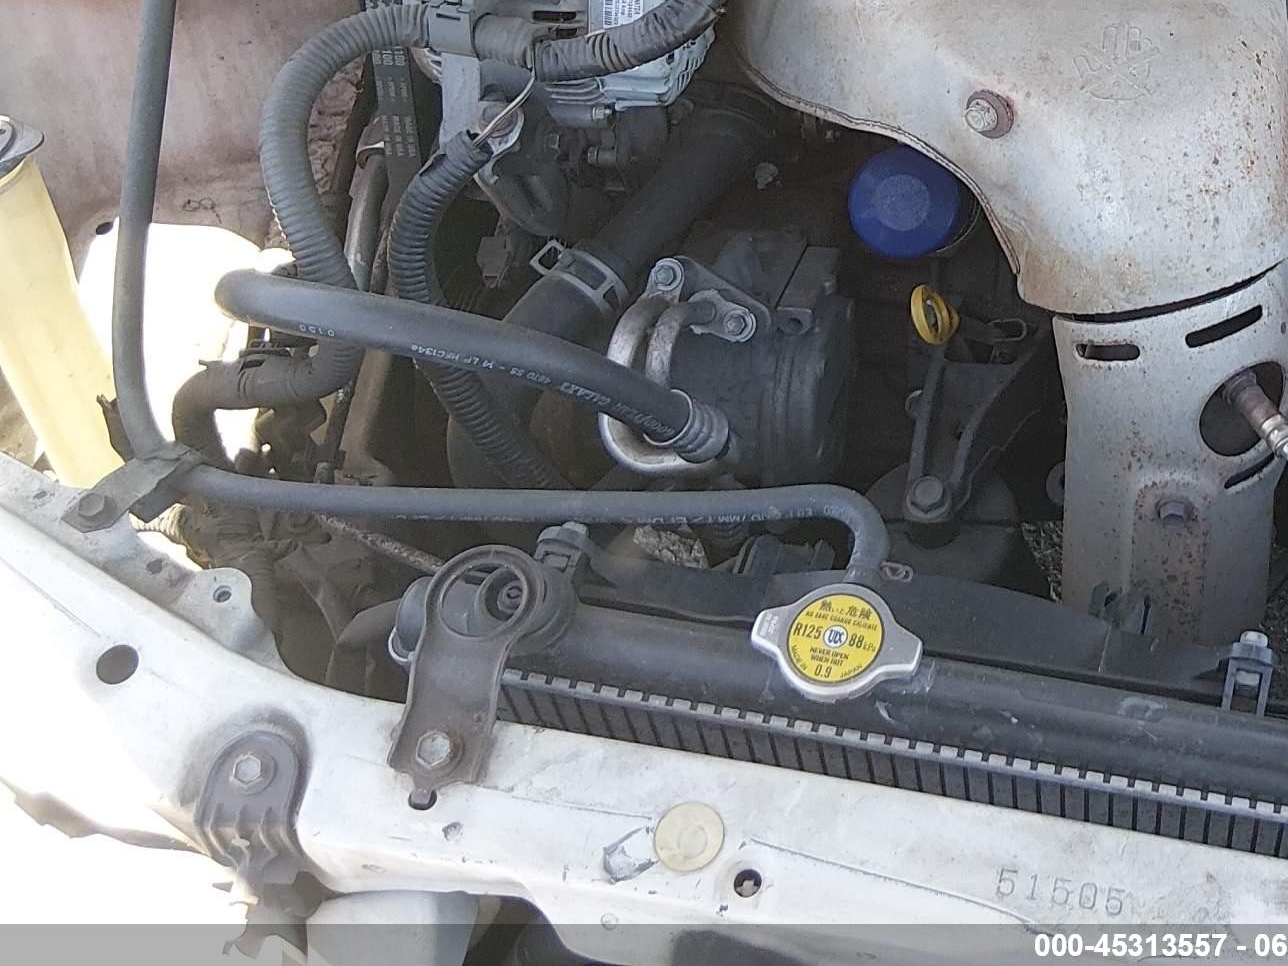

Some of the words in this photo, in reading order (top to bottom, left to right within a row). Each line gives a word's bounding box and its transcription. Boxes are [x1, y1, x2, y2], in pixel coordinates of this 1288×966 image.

[793, 622, 823, 640] R125
[848, 633, 865, 649] 88
[814, 664, 833, 678] 0.9
[996, 866, 1126, 916] 51505
